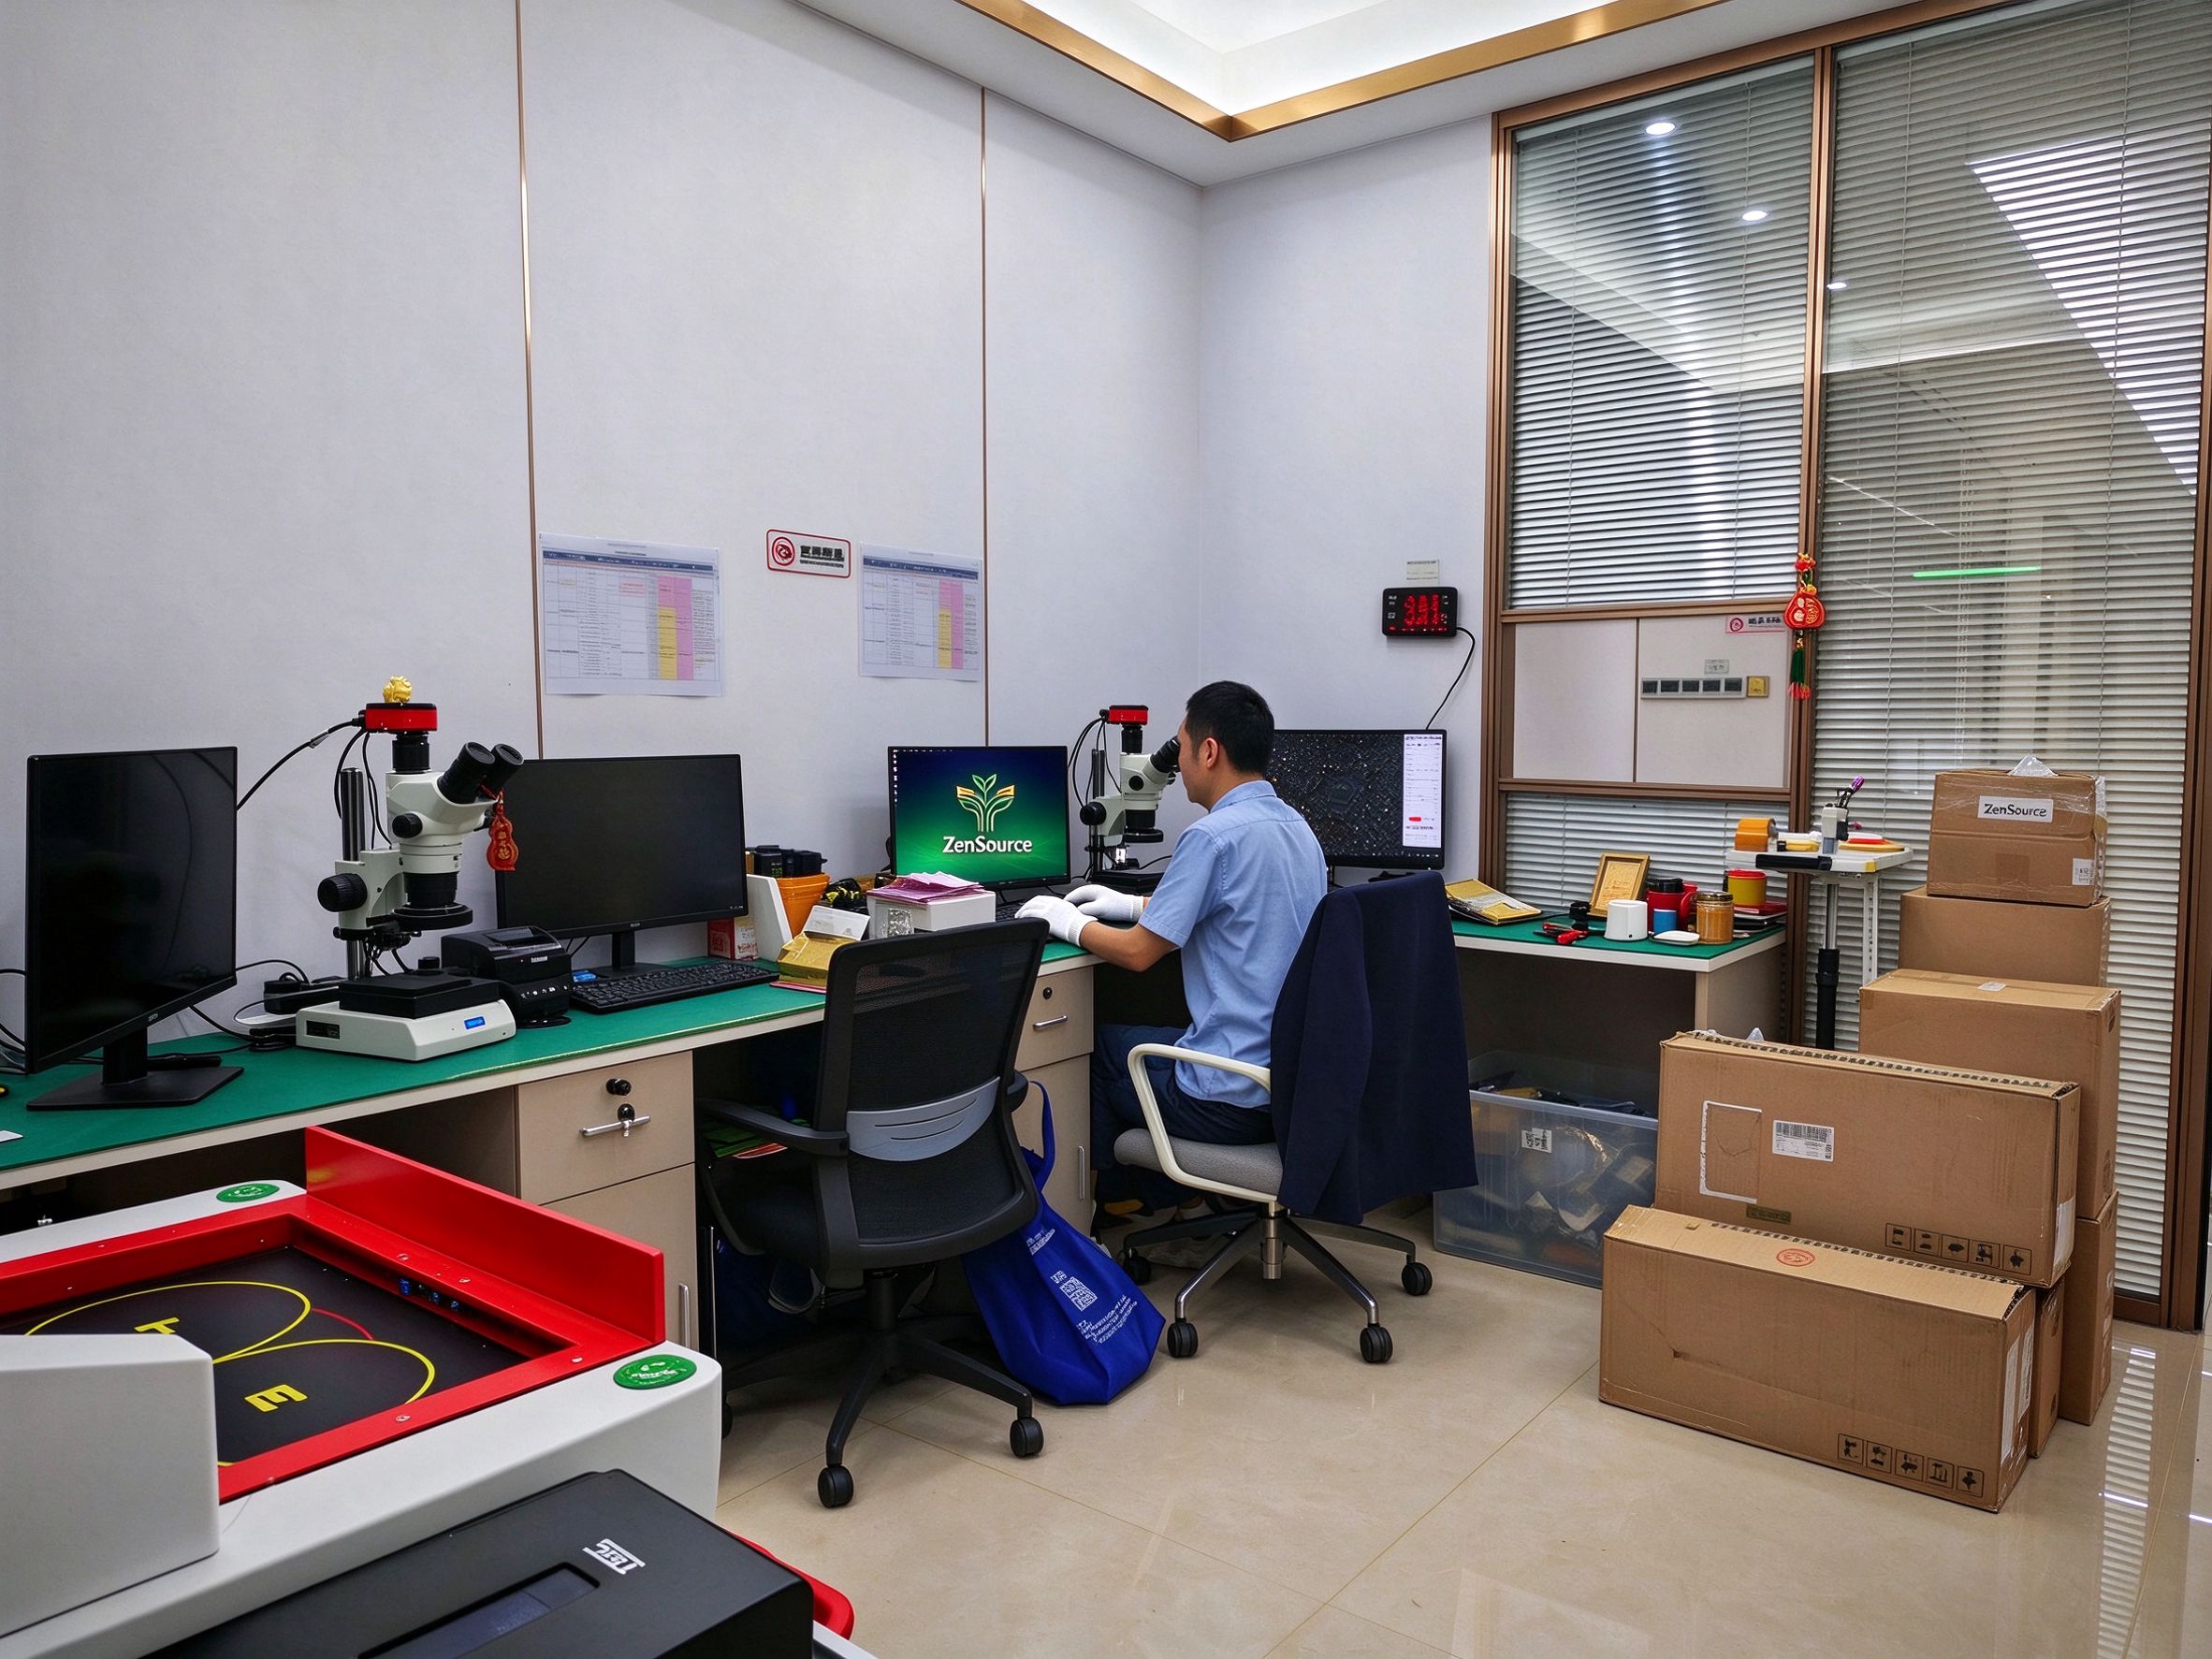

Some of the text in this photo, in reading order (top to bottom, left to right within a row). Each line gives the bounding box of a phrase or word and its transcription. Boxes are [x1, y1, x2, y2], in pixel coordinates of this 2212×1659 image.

[1984, 804, 2047, 817] ZenSource
[942, 836, 1033, 853] ZenSource
[244, 1384, 308, 1412] E
